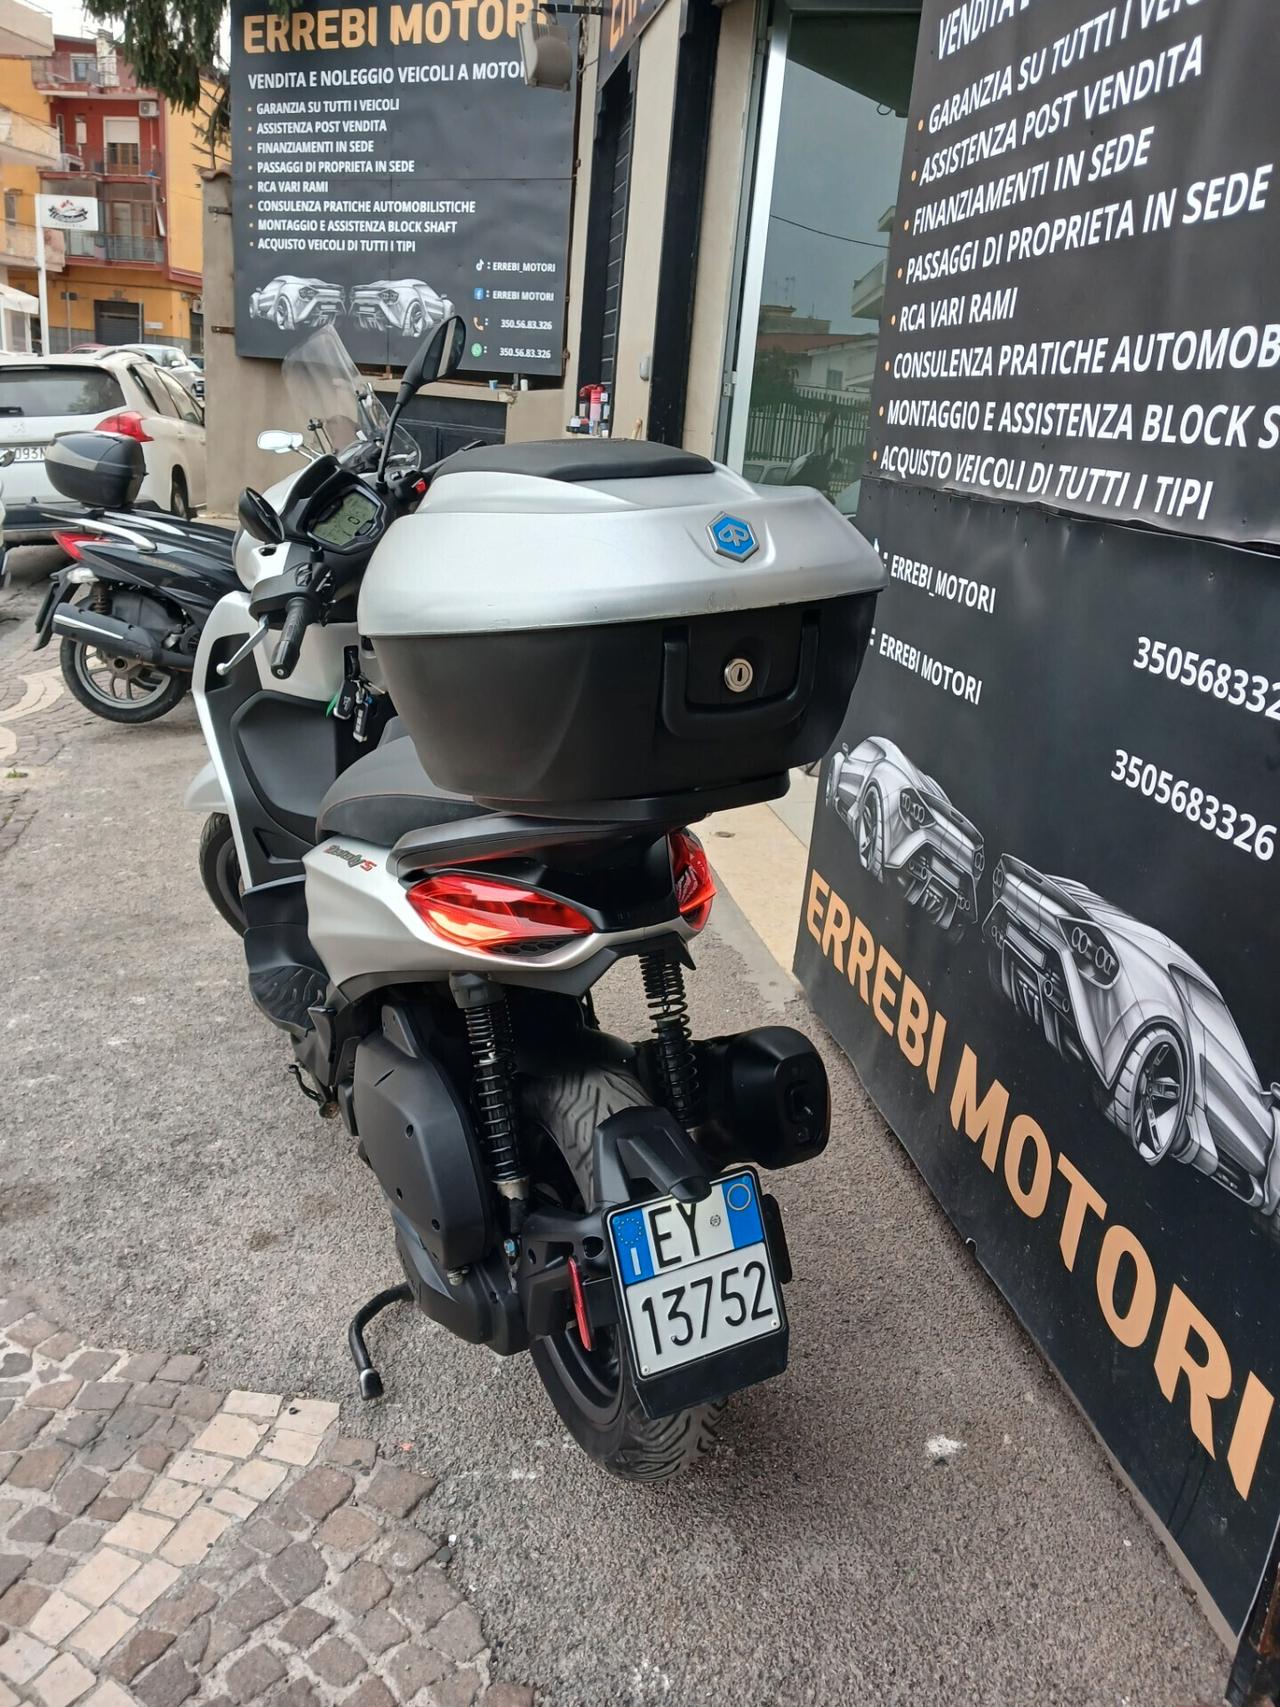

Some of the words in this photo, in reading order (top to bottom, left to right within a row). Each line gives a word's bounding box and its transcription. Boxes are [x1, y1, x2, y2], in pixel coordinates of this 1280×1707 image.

[244, 6, 377, 54] ERREBI
[248, 72, 307, 90] VENDITA
[309, 71, 318, 87] E
[320, 67, 395, 87] NOLEGGIO
[397, 64, 455, 83] VEICOLI
[457, 63, 469, 80] A
[472, 60, 525, 80] MOTO
[928, 65, 1012, 134] GARANZIA
[1017, 47, 1047, 92] SU
[1051, 7, 1116, 75] TUTTI
[1121, 0, 1132, 39] I
[256, 101, 306, 115] GARANZIA
[308, 101, 322, 113] SU
[323, 100, 352, 113] TUTTI
[353, 100, 358, 112] I
[359, 98, 400, 112] VEICOLI
[256, 121, 313, 134] ASSISTENZA
[315, 120, 341, 133] POST
[342, 119, 387, 132] VENDITA
[919, 118, 1017, 186] ASSISTENZA
[1022, 90, 1078, 146] POST
[1084, 34, 1203, 120] VENDITA
[256, 141, 334, 153] FINANZIAMENTI
[335, 141, 348, 153] IN
[349, 140, 374, 152] SEDE
[257, 161, 303, 173] PASSAGGI
[305, 161, 317, 173] DI
[318, 160, 373, 173] PROPRIETA
[375, 160, 387, 172] IN
[388, 160, 415, 172] SEDE
[257, 181, 277, 193] RCA
[278, 181, 300, 193] VARI
[302, 181, 329, 193] RAMI
[912, 162, 1050, 237] FINANZIAMENTI
[1053, 149, 1086, 192] IN
[1087, 125, 1155, 182] SEDE
[257, 200, 321, 212] CONSULENZA
[323, 201, 371, 212] PRATICHE
[372, 201, 476, 213] AUTOMOBILISTICHE
[257, 219, 318, 231] MONTAGGIO
[319, 220, 326, 231] E
[327, 220, 386, 232] ASSISTENZA
[388, 221, 422, 233] BLOCK
[423, 221, 458, 233] SHAFT
[905, 239, 978, 285] PASSAGGI
[981, 232, 1004, 268] DI
[1006, 199, 1134, 260] PROPRIETA
[1142, 187, 1177, 233] IN
[1181, 163, 1274, 226] SEDE
[257, 238, 306, 252] ACQUISTO
[307, 239, 345, 251] VEICOLI
[347, 240, 358, 251] DI
[359, 240, 388, 252] TUTTI
[389, 241, 394, 252] I
[395, 241, 416, 252] TIPI
[492, 290, 520, 300] ERREBI
[521, 291, 554, 301] MOTORI
[899, 303, 926, 332] RCA
[930, 296, 965, 327] VARI
[968, 287, 1019, 324] RAMI
[893, 345, 993, 379] CONSULENZA
[997, 337, 1109, 377] PRATICHE
[1110, 323, 1280, 374] AUTOMOB
[886, 399, 980, 432] MONTAGGIO
[983, 402, 996, 431] E
[997, 401, 1134, 441] ASSISTENZA
[1141, 404, 1256, 449] BLOCK
[880, 444, 952, 480] ACQUISTO
[955, 453, 1025, 493] VEICOLI
[1026, 461, 1054, 497] DI
[1054, 463, 1132, 507] TUTTI
[1132, 473, 1149, 510] I
[1153, 476, 1214, 521] TIPI
[890, 554, 996, 614] ERREBI_MOTORI
[879, 633, 921, 673] ERREBI
[920, 654, 983, 705] MOTORI
[1110, 748, 1278, 862] 3505683326
[805, 869, 947, 1094] ERREBI
[949, 1043, 1276, 1502] MOTORI
[648, 1202, 700, 1269] EY
[641, 1260, 773, 1356] 13752
